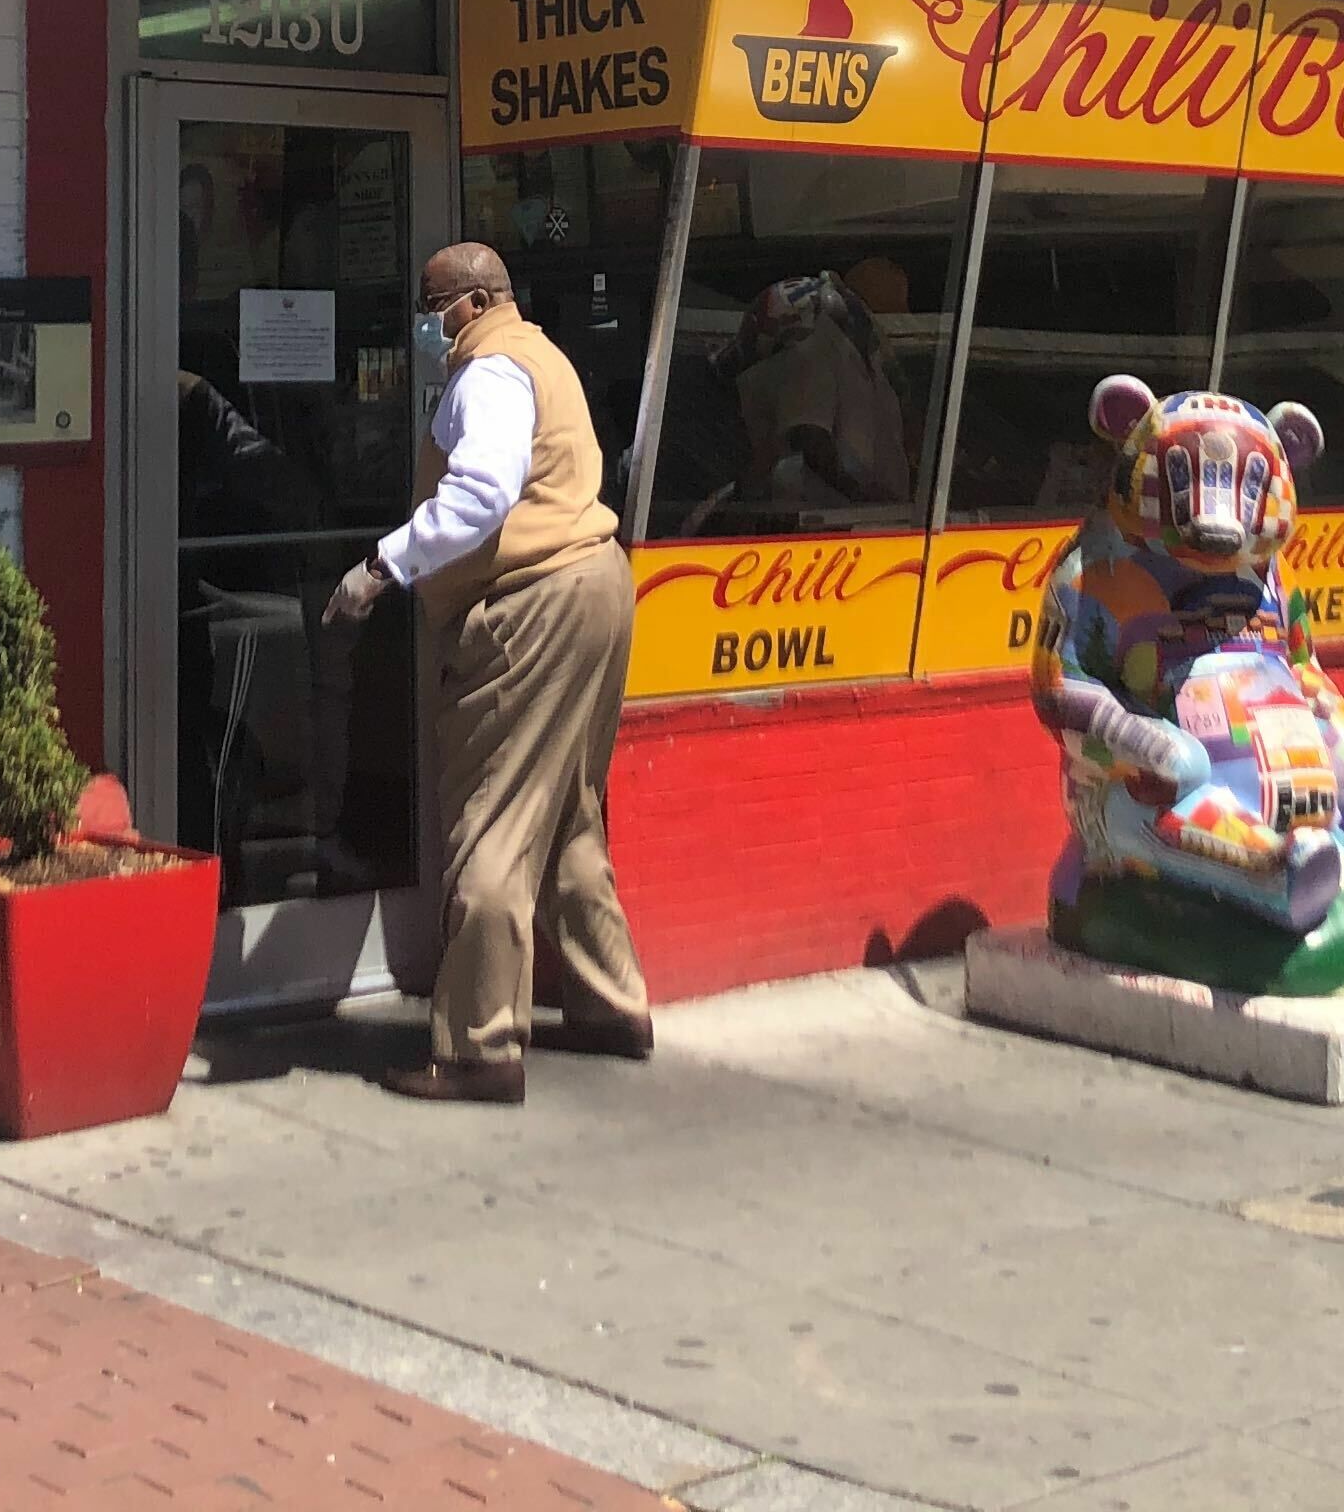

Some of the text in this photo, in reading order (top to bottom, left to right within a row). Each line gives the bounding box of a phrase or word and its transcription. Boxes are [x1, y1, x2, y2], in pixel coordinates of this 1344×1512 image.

[491, 46, 670, 126] SHAKES
[761, 48, 869, 108] BEN'S
[712, 545, 863, 609] Chili
[712, 625, 835, 675] BOWL
